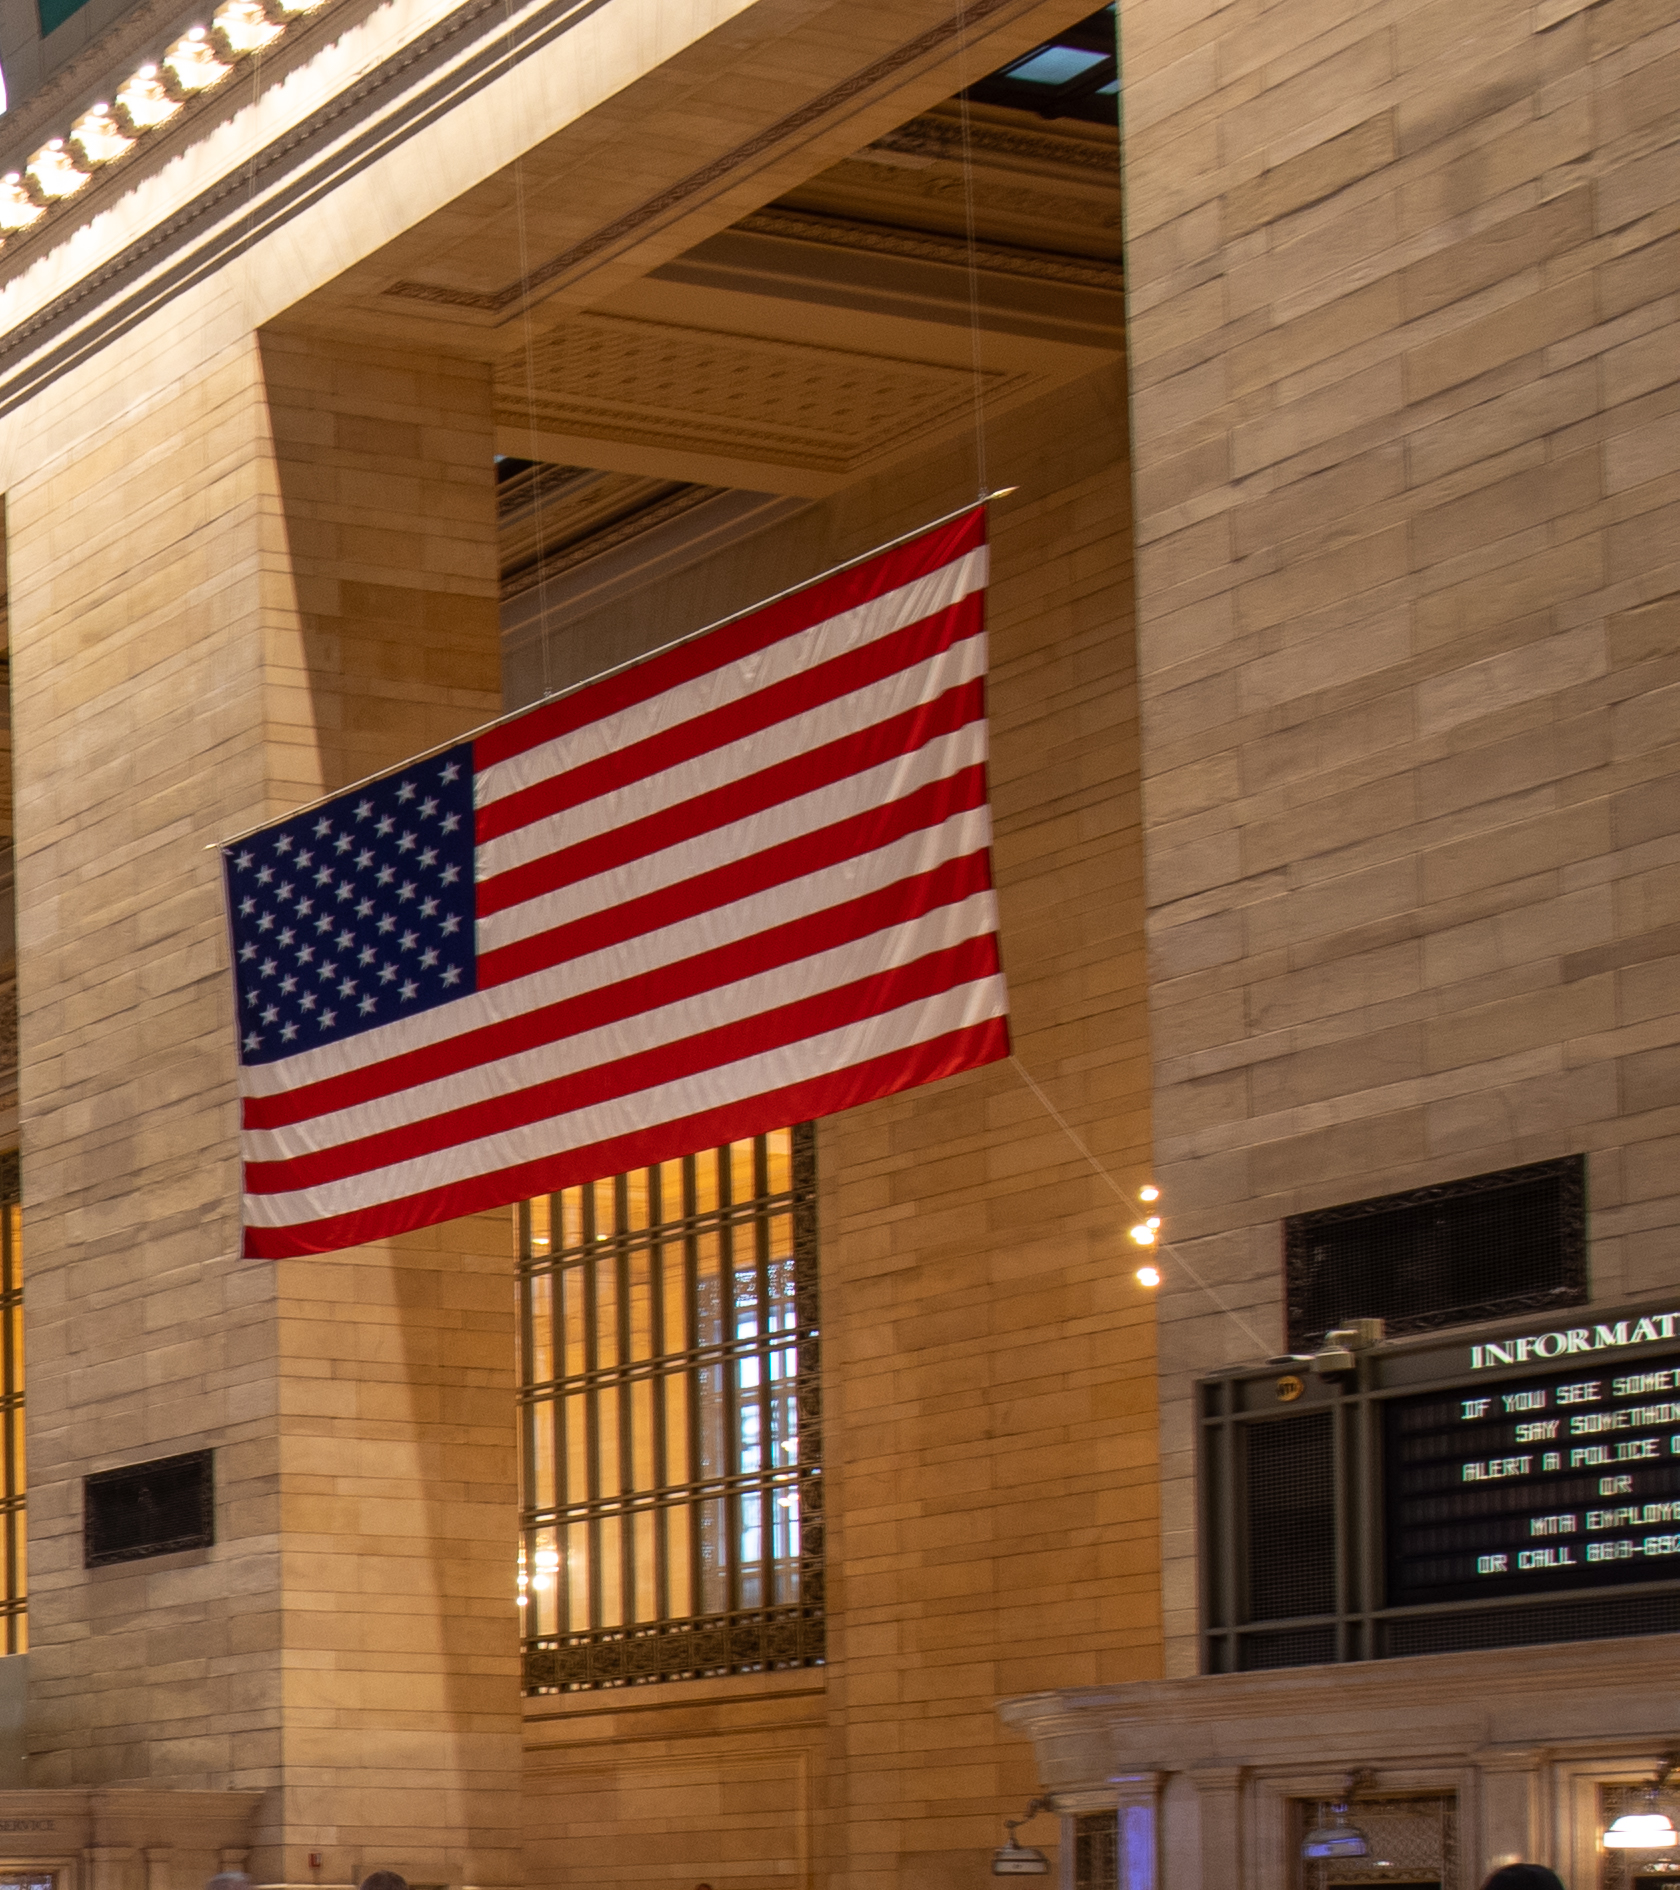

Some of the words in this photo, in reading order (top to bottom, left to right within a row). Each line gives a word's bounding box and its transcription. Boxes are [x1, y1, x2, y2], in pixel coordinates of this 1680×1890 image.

[1461, 1399, 1491, 1420] IF
[1502, 1390, 1547, 1413] YOU
[1556, 1381, 1602, 1404] SEE
[1515, 1419, 1559, 1442] SAY
[1462, 1455, 1534, 1482] ALERT
[1543, 1452, 1561, 1471] A
[1571, 1438, 1660, 1468] POLICE
[1599, 1475, 1633, 1496] OR
[1531, 1514, 1577, 1536] MTA
[1477, 1554, 1508, 1574] OR
[1518, 1547, 1577, 1570] CALL
